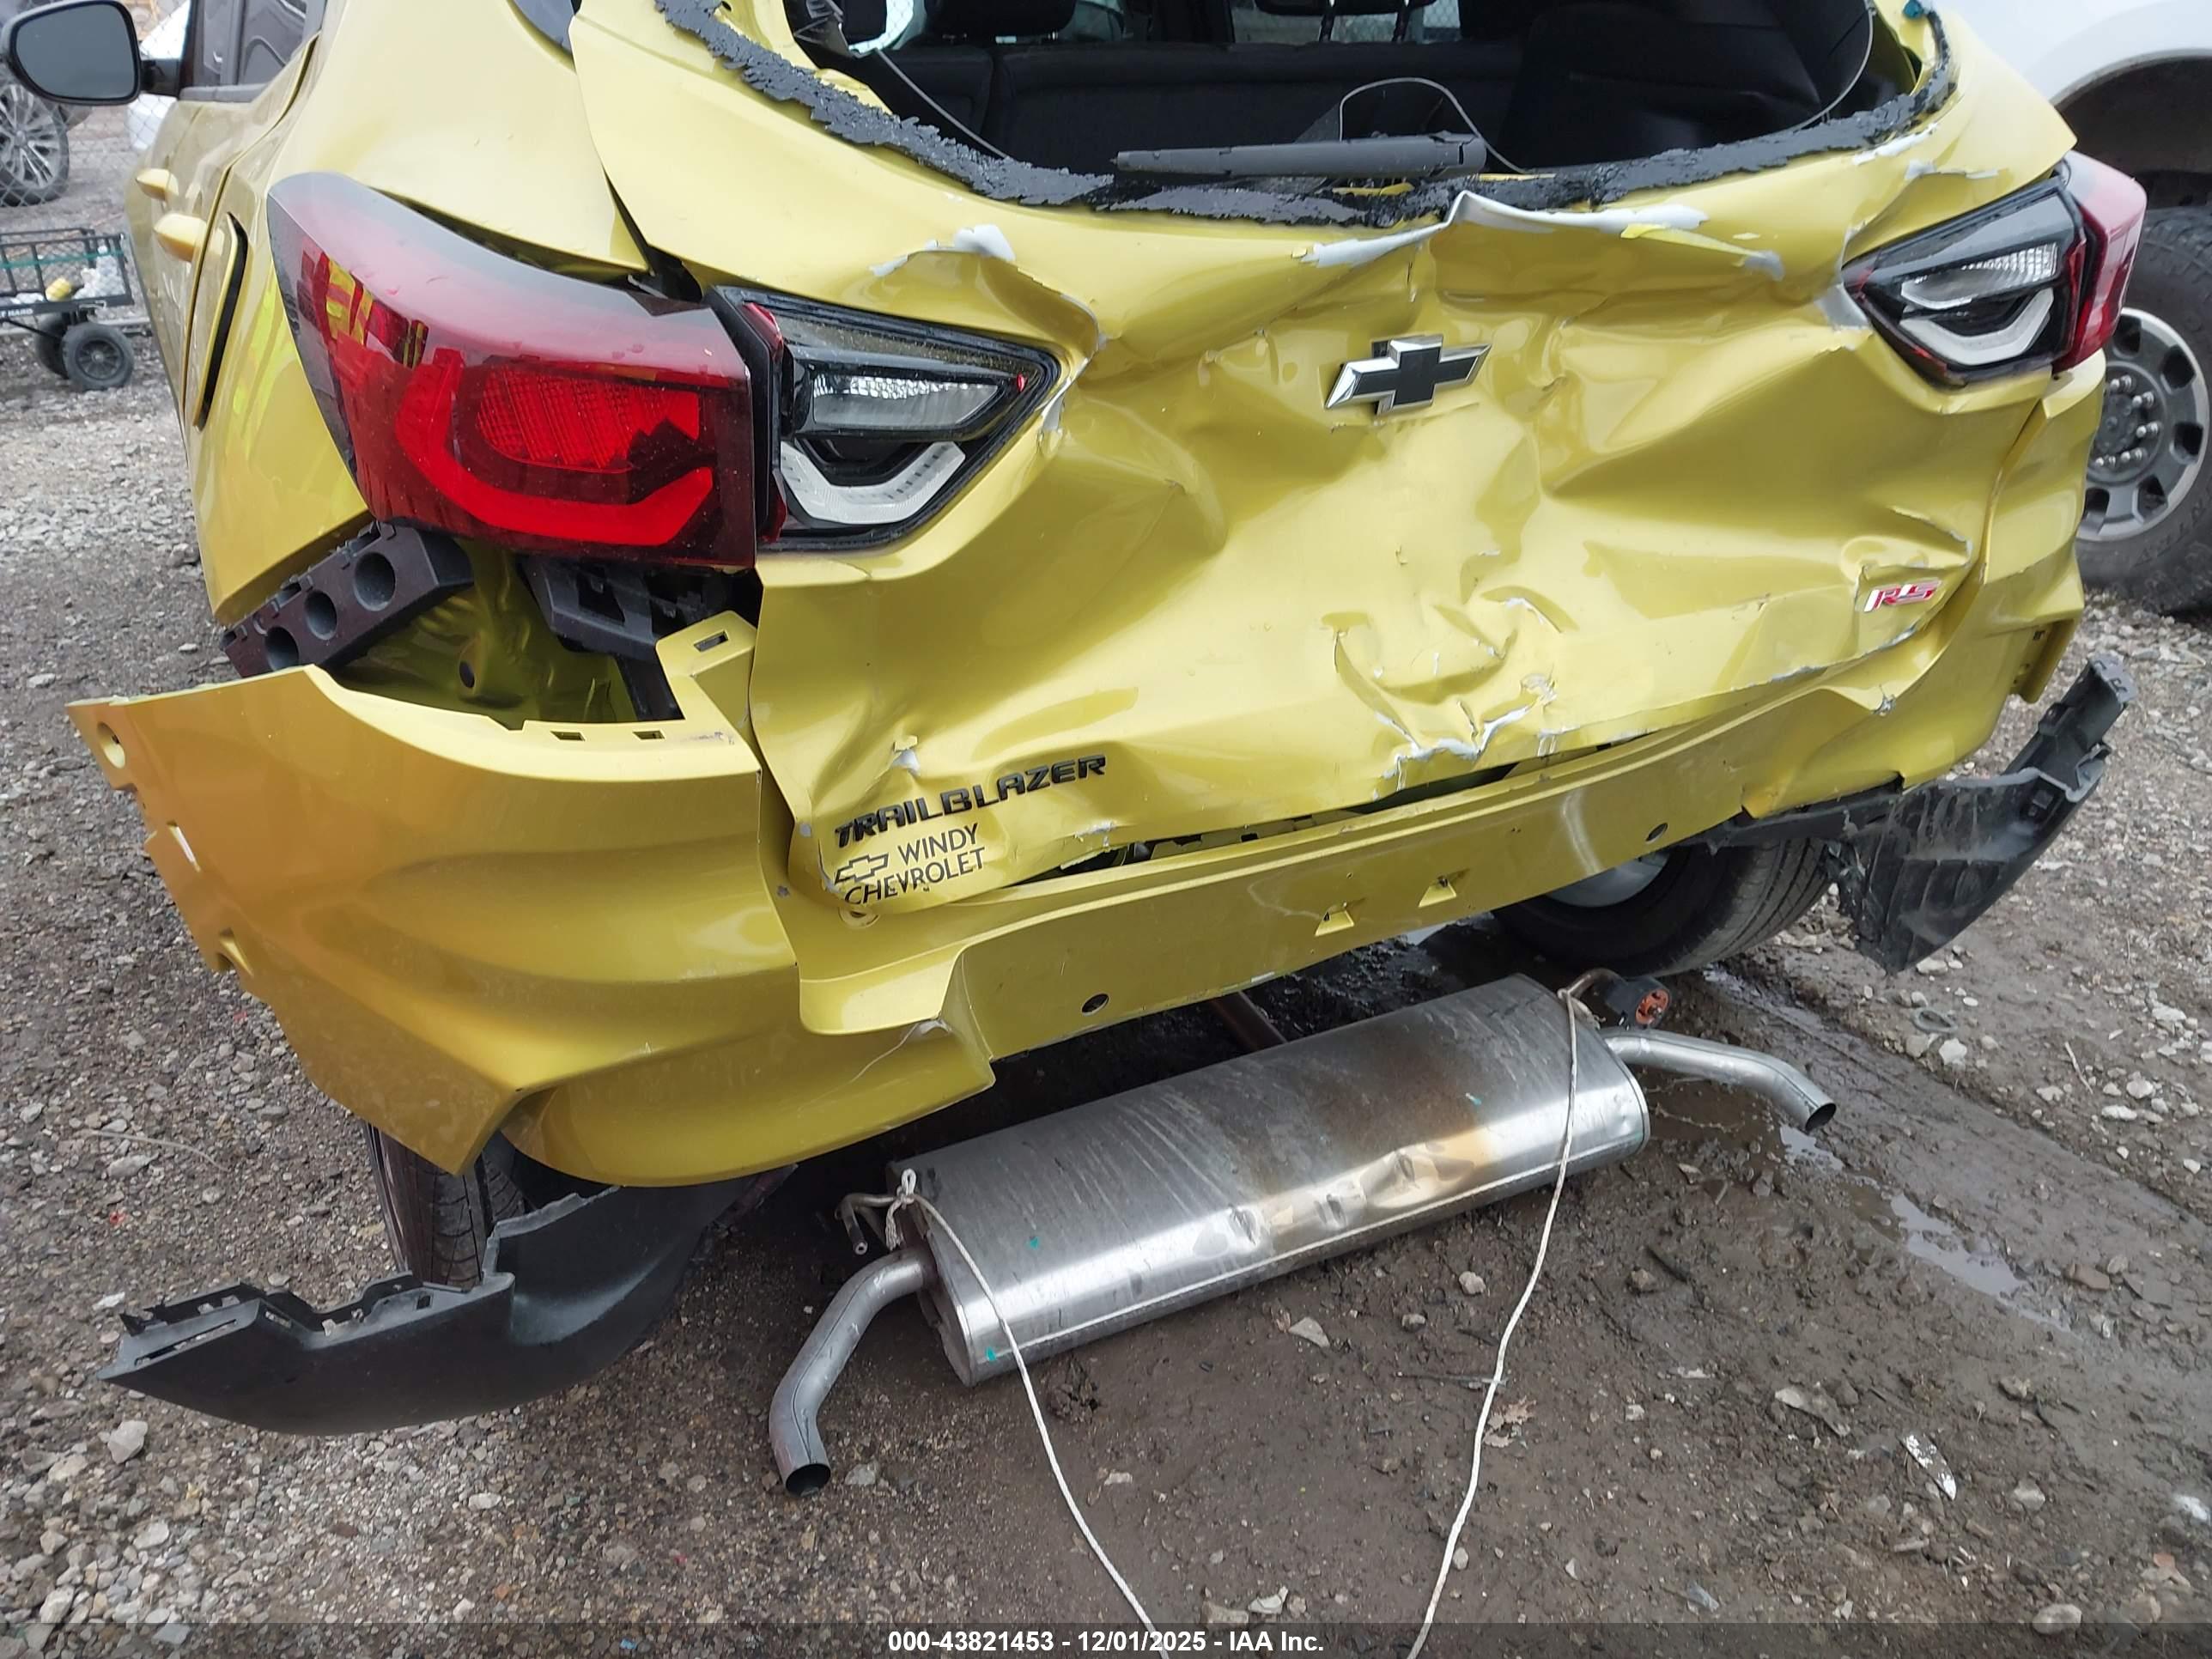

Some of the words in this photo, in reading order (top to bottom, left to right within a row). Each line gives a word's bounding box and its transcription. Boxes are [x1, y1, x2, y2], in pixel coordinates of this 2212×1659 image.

[1863, 577, 1942, 612] RS
[835, 754, 1106, 848] TRAILBLAZER
[897, 823, 978, 866] WINDY
[845, 847, 985, 905] CHEVROLET
